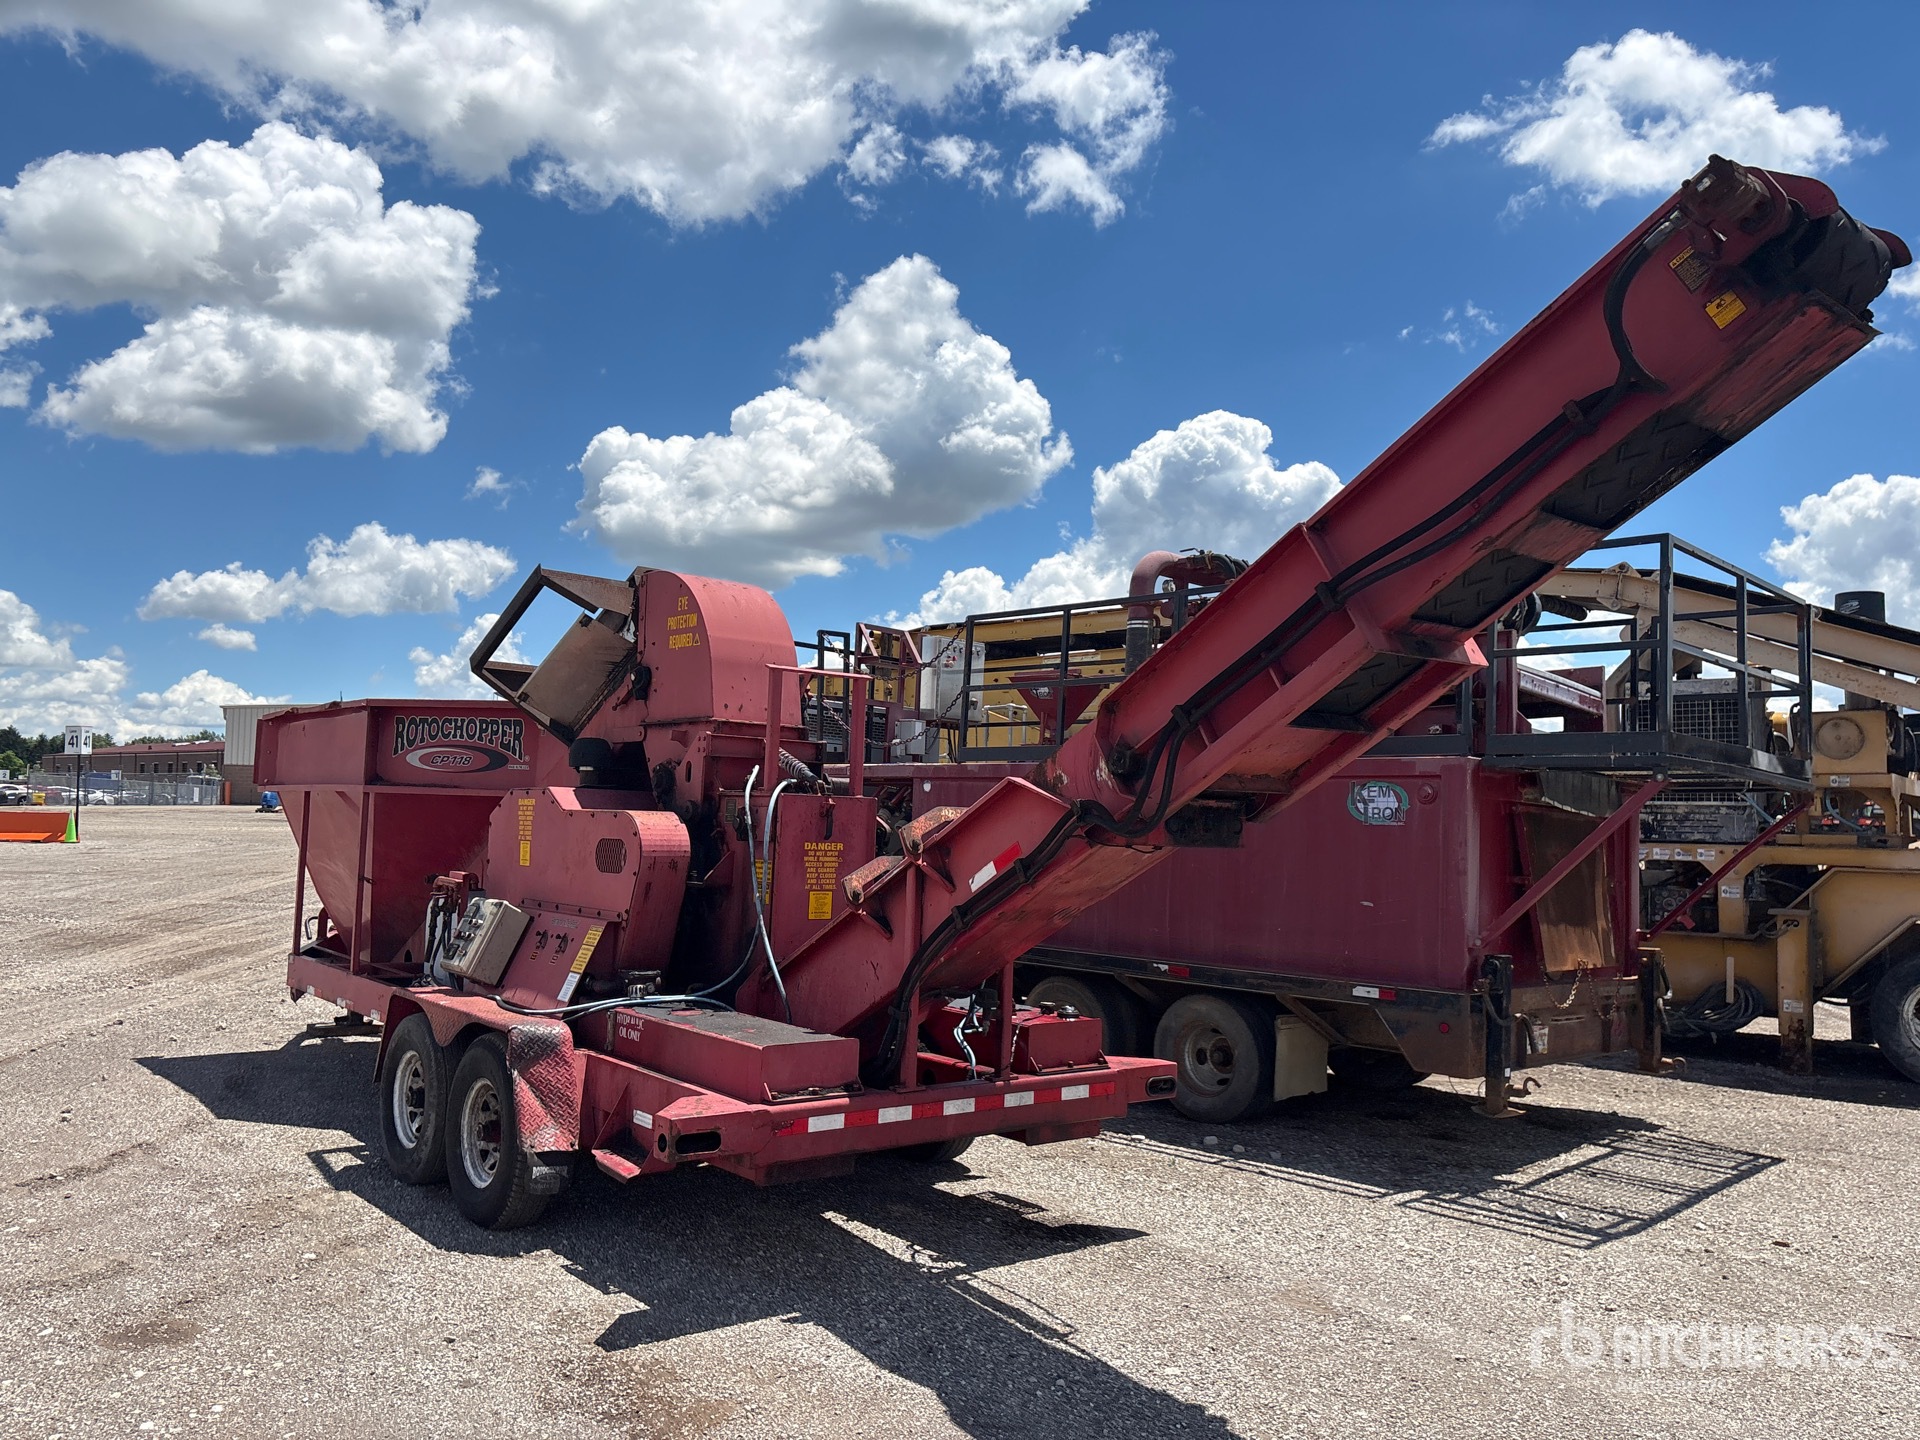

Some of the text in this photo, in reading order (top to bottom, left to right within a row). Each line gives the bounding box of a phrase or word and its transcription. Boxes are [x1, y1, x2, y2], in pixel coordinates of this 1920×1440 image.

[678, 596, 688, 611] EYE
[667, 613, 698, 630] PROTECTION
[669, 633, 693, 650] REQUIRED
[67, 735, 79, 748] 41
[83, 735, 91, 748] 41
[392, 715, 525, 762] ROTOCHOPPER
[430, 755, 473, 767] CP118
[1350, 781, 1391, 807] KEM
[1363, 806, 1405, 825] IRON
[804, 842, 843, 850] DANGER
[619, 1026, 641, 1042] OIL ONLY
